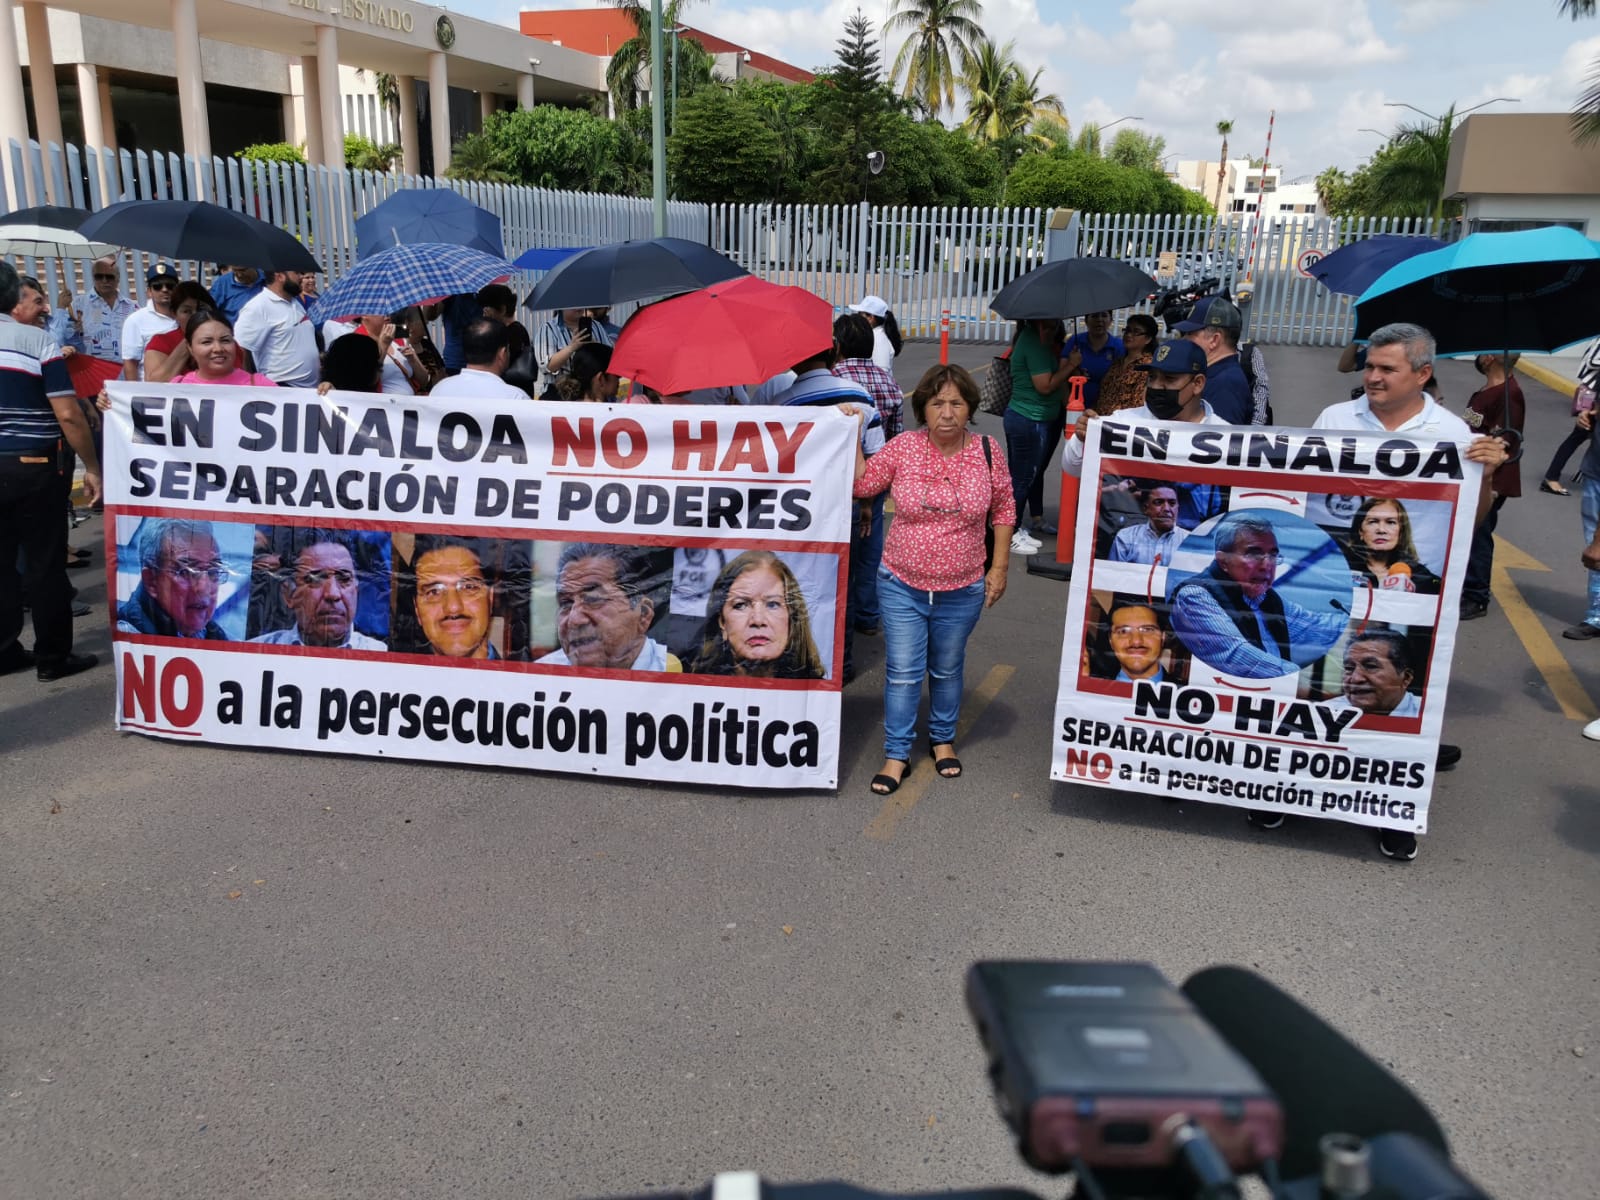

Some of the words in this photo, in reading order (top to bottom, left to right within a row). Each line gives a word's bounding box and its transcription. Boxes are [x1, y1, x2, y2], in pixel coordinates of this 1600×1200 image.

[342, 0, 414, 32] ESTADO
[1305, 256, 1319, 266] 10
[131, 396, 215, 448] EN
[239, 400, 528, 464] SINALOA
[551, 416, 648, 469] NO
[672, 420, 814, 473] HAY
[1100, 421, 1170, 460] EN
[1188, 431, 1464, 480] SINALOA
[129, 458, 459, 515] SEPARACIÓN
[475, 478, 542, 519] DE
[558, 481, 812, 531] PODERES
[123, 652, 204, 728] NO
[217, 680, 243, 725] a
[259, 670, 303, 729] la
[318, 688, 607, 755] persecución
[625, 702, 819, 768] política
[1135, 682, 1215, 725] NO
[1234, 695, 1359, 743] HAY
[1062, 717, 1235, 766] SEPARACIÓN
[1243, 743, 1281, 772] DE
[1289, 749, 1426, 789] PODERES
[1066, 747, 1113, 780] NO
[1119, 762, 1133, 781] a
[1140, 761, 1160, 785] la
[1167, 769, 1314, 807] persecución
[1321, 790, 1416, 820] política
